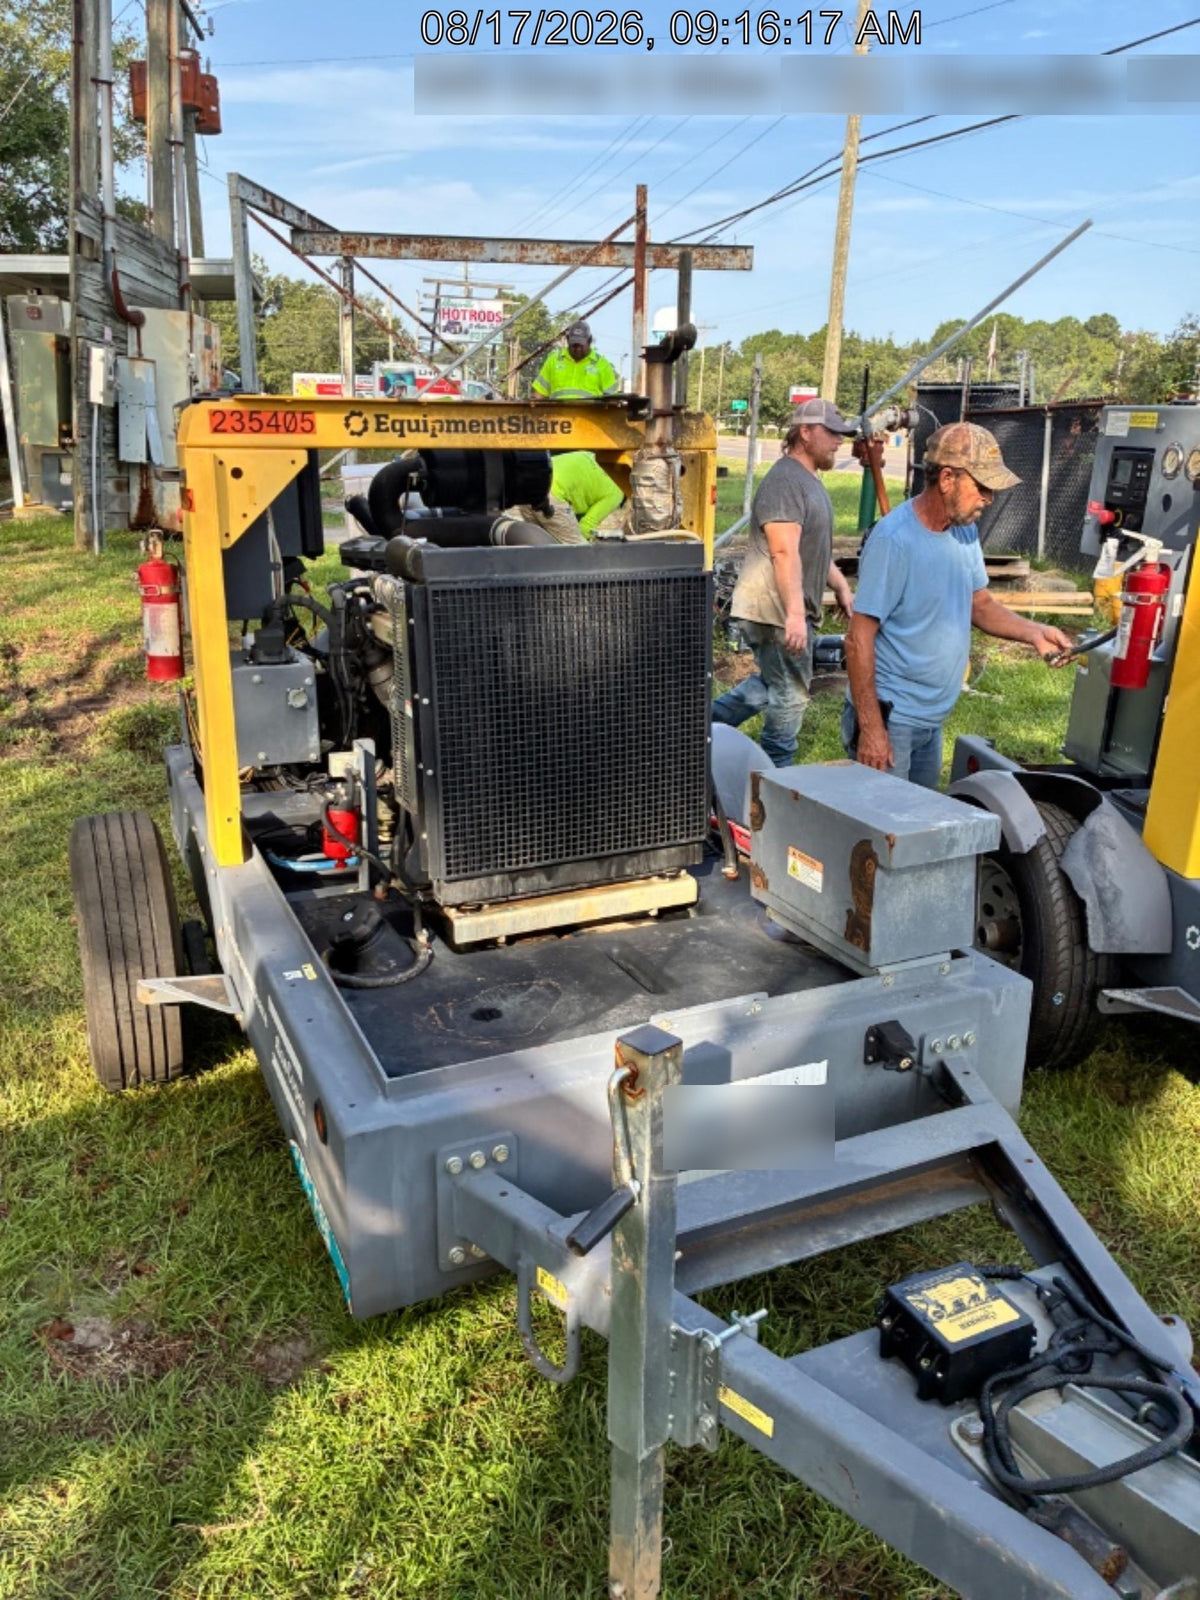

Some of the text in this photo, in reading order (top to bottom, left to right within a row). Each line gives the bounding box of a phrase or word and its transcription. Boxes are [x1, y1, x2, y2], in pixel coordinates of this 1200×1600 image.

[441, 308, 502, 322] HOTRODS
[211, 410, 315, 433] 235405
[373, 413, 573, 437] EquipmentShare
